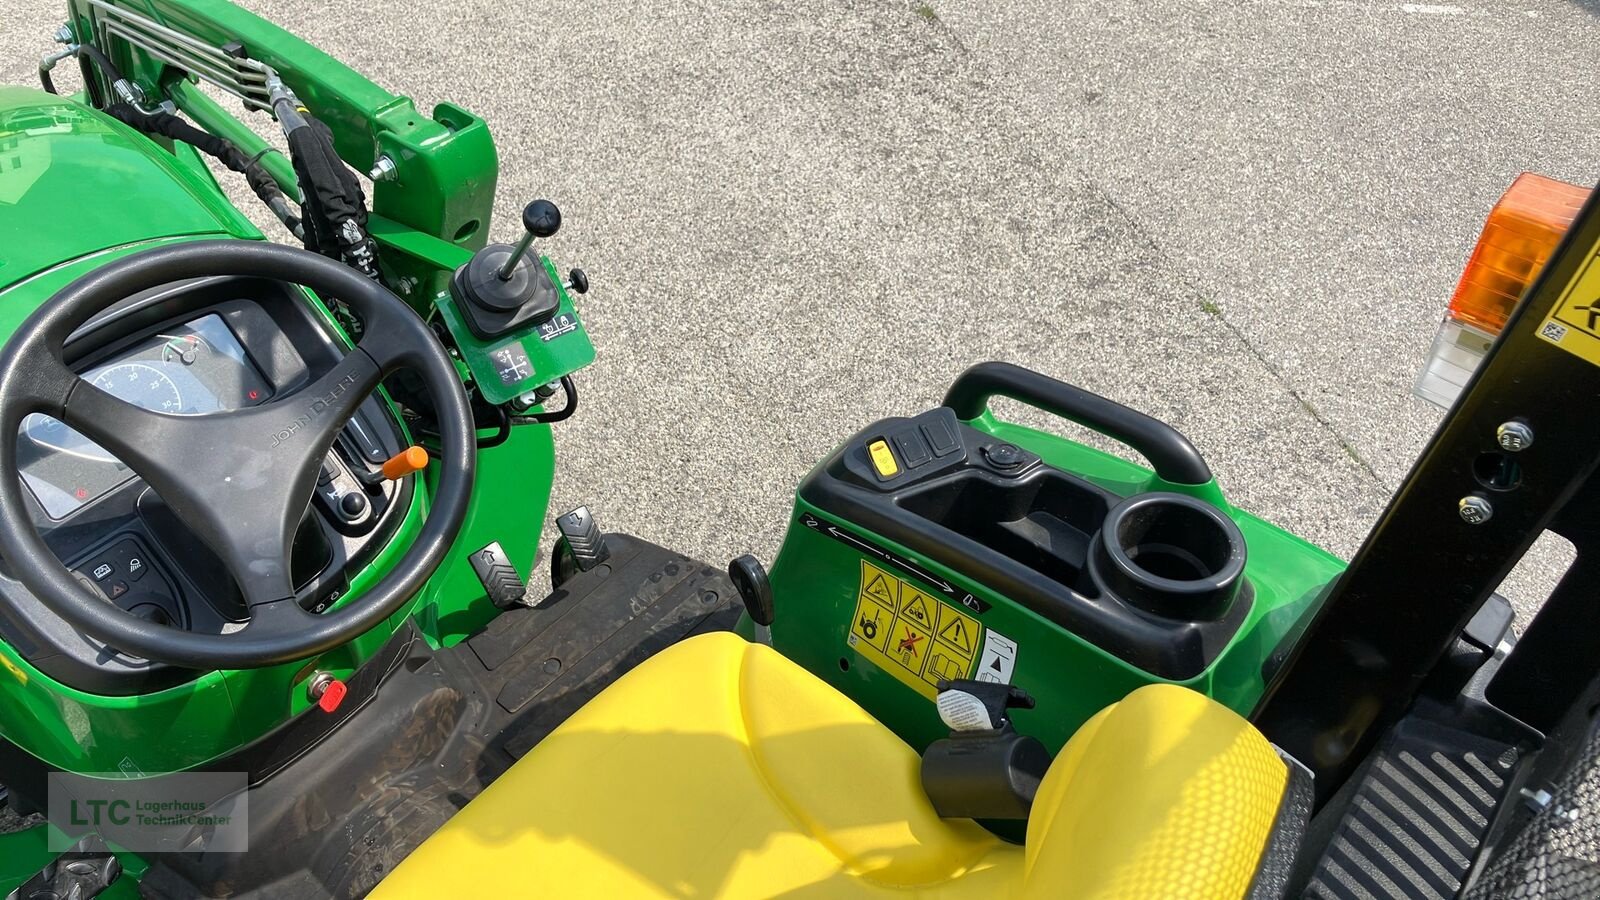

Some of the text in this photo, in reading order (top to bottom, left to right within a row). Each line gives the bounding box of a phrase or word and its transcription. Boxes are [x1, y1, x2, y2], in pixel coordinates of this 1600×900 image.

[128, 372, 139, 382] 20
[105, 381, 114, 390] 15
[150, 382, 160, 391] 25
[162, 400, 172, 409] 30
[272, 368, 360, 448] JOHN DEERE
